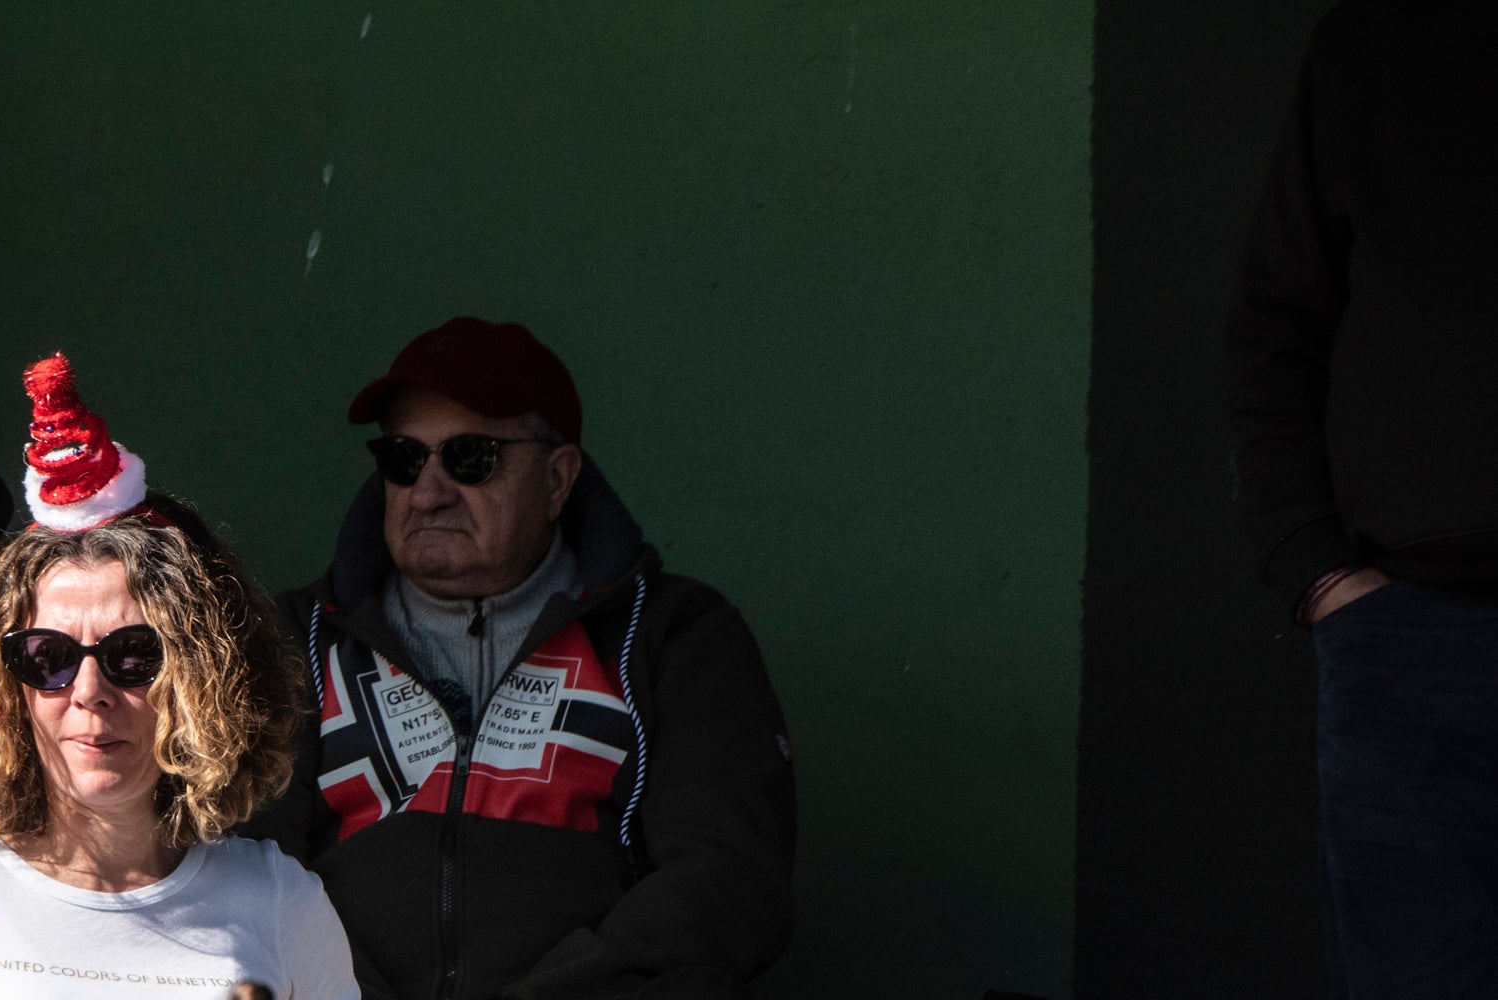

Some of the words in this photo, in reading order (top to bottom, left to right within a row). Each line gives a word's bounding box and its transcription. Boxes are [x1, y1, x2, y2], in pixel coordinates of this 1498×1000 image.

[530, 711, 541, 723] E
[486, 719, 546, 736] TRADEMARK
[486, 736, 516, 750] SINCE
[50, 966, 120, 982] COLORS
[127, 973, 150, 983] OF
